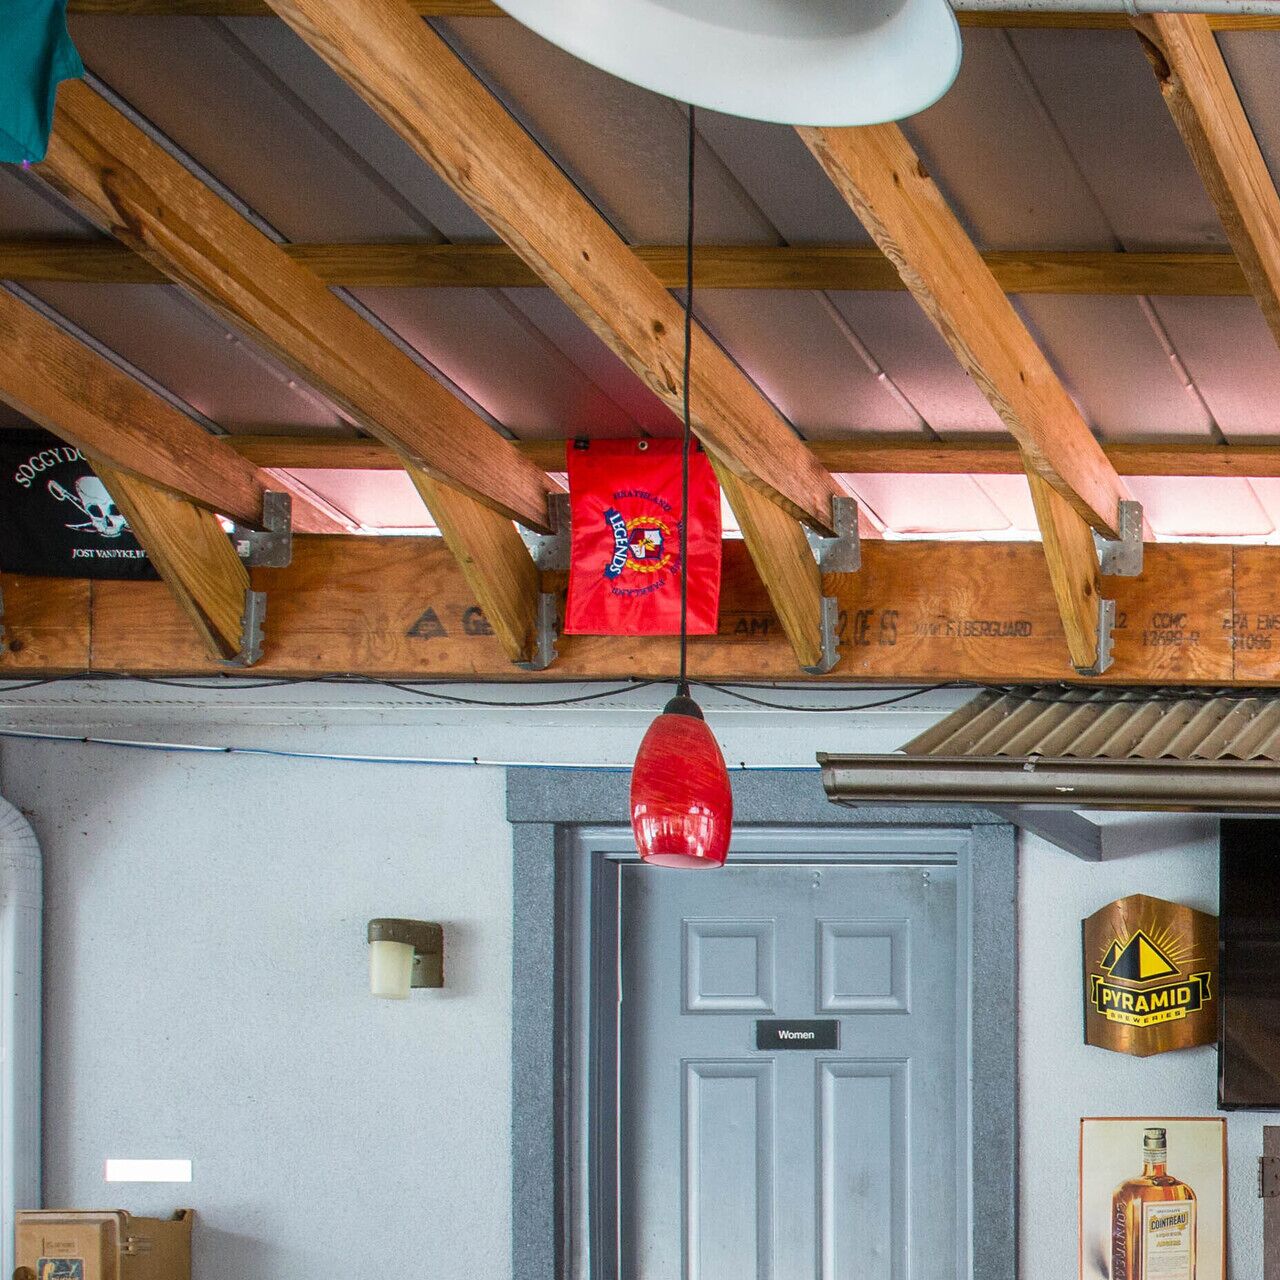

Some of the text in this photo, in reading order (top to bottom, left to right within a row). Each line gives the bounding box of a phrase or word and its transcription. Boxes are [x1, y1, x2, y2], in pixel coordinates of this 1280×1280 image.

[15, 447, 62, 488] SOGGY
[609, 513, 628, 575] LEGENDS
[72, 549, 94, 558] JOST
[1102, 986, 1191, 1012] PYRAMID
[1110, 1010, 1181, 1023] BREWERIES
[778, 1030, 815, 1040] Women
[1151, 1213, 1186, 1230] COINTREAU
